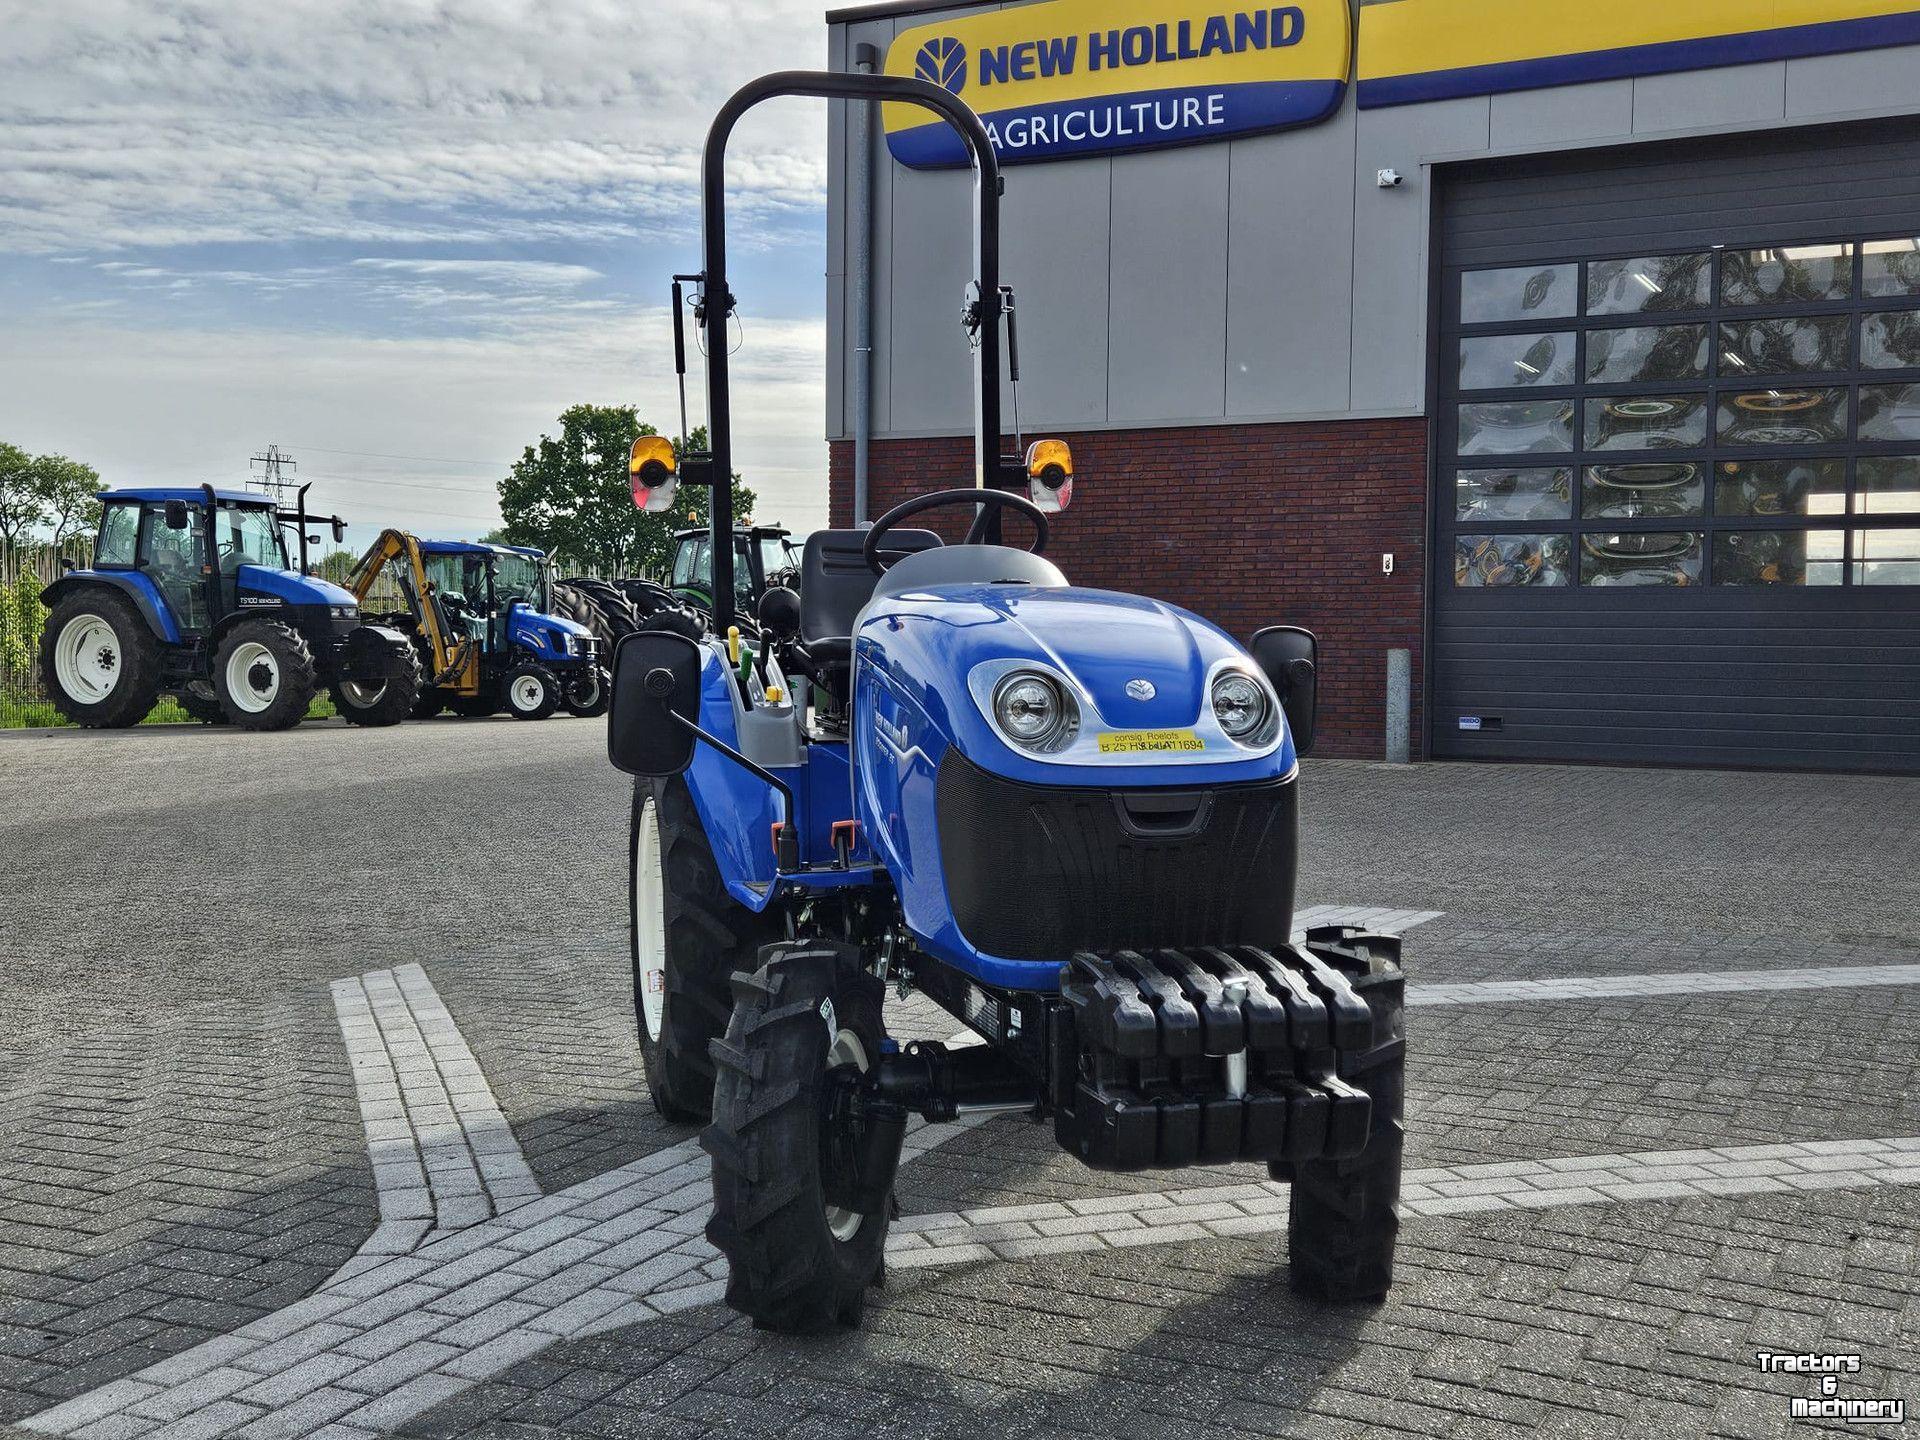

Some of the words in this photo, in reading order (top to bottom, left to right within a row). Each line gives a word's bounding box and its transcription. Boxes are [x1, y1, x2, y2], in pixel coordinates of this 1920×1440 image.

[979, 35, 1077, 86] NEW
[1089, 5, 1305, 71] HOLLAND
[985, 93, 1224, 150] AGRICULTURE
[1113, 742, 1127, 752] 25
